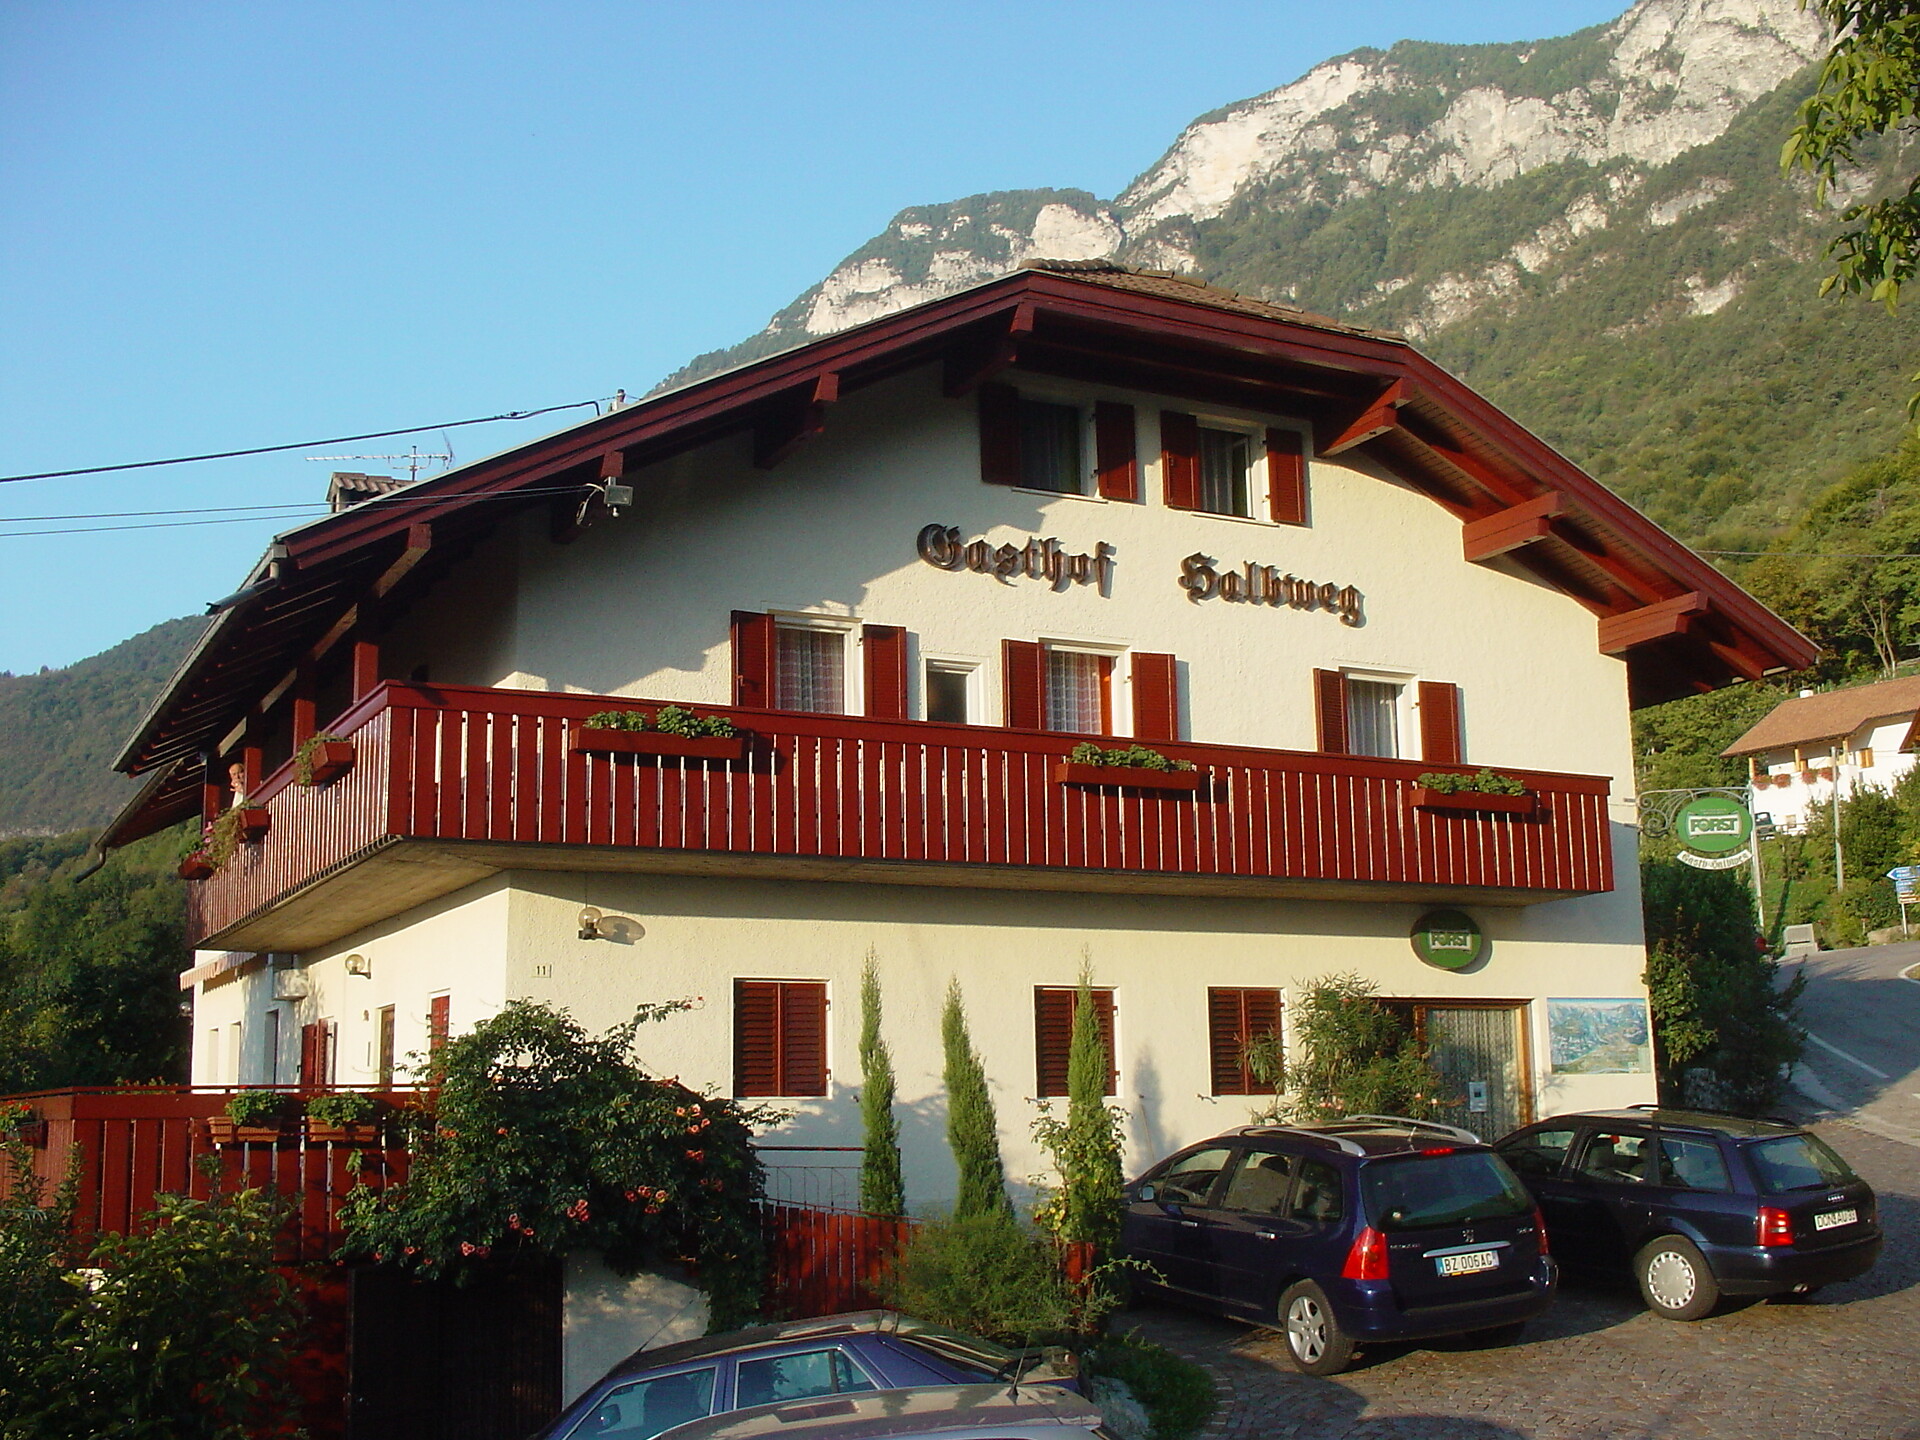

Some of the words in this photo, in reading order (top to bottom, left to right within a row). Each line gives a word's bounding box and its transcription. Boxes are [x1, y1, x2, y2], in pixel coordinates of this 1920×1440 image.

[917, 523, 1115, 598] Gasthof
[1178, 552, 1365, 627] Halbweg
[1691, 818, 1737, 833] FORST
[1432, 931, 1467, 946] FORST
[537, 965, 546, 975] 11
[1444, 1258, 1458, 1272] BZ
